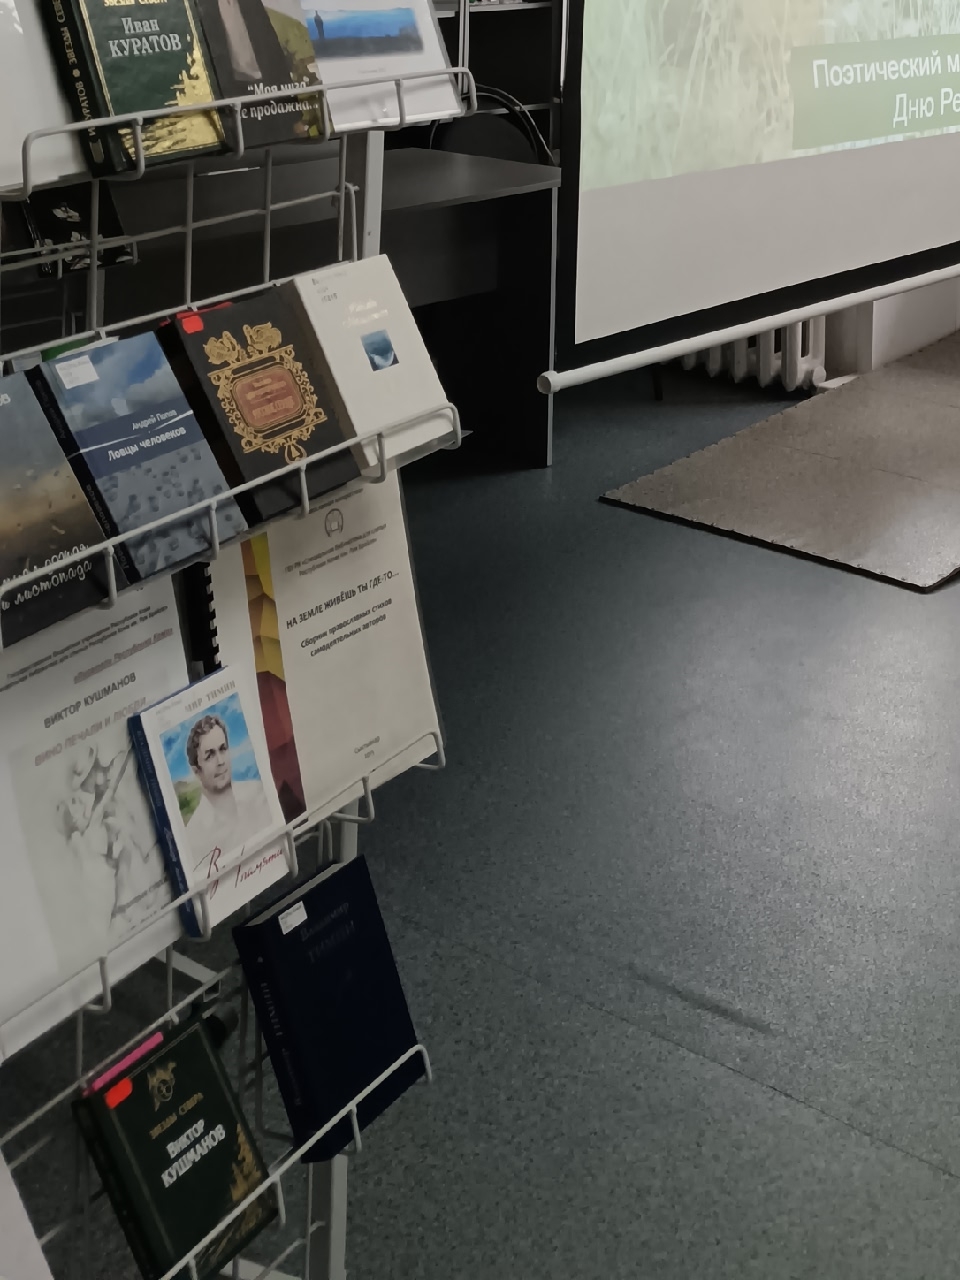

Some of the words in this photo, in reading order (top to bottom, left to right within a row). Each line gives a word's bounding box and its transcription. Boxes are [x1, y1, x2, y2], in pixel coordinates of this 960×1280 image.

[108, 33, 182, 58] КУРАТОВ
[121, 18, 160, 34] Иван
[812, 49, 943, 89] Поэтический
[893, 92, 935, 128] Дню
[107, 444, 139, 462] Ловцы
[139, 426, 187, 448] человеков
[14, 558, 93, 606] листопада
[286, 616, 298, 629] НА
[299, 604, 324, 623] ЗЕМЛЕ
[323, 588, 357, 610] ЖИВЁШЬ
[357, 582, 369, 593] ТЫ
[43, 700, 82, 729] ВИКТОР
[83, 671, 137, 707] КУШМАНОВ
[160, 1123, 226, 1189] КУШМАНОВ
[166, 1118, 205, 1159] ВИКТОР
